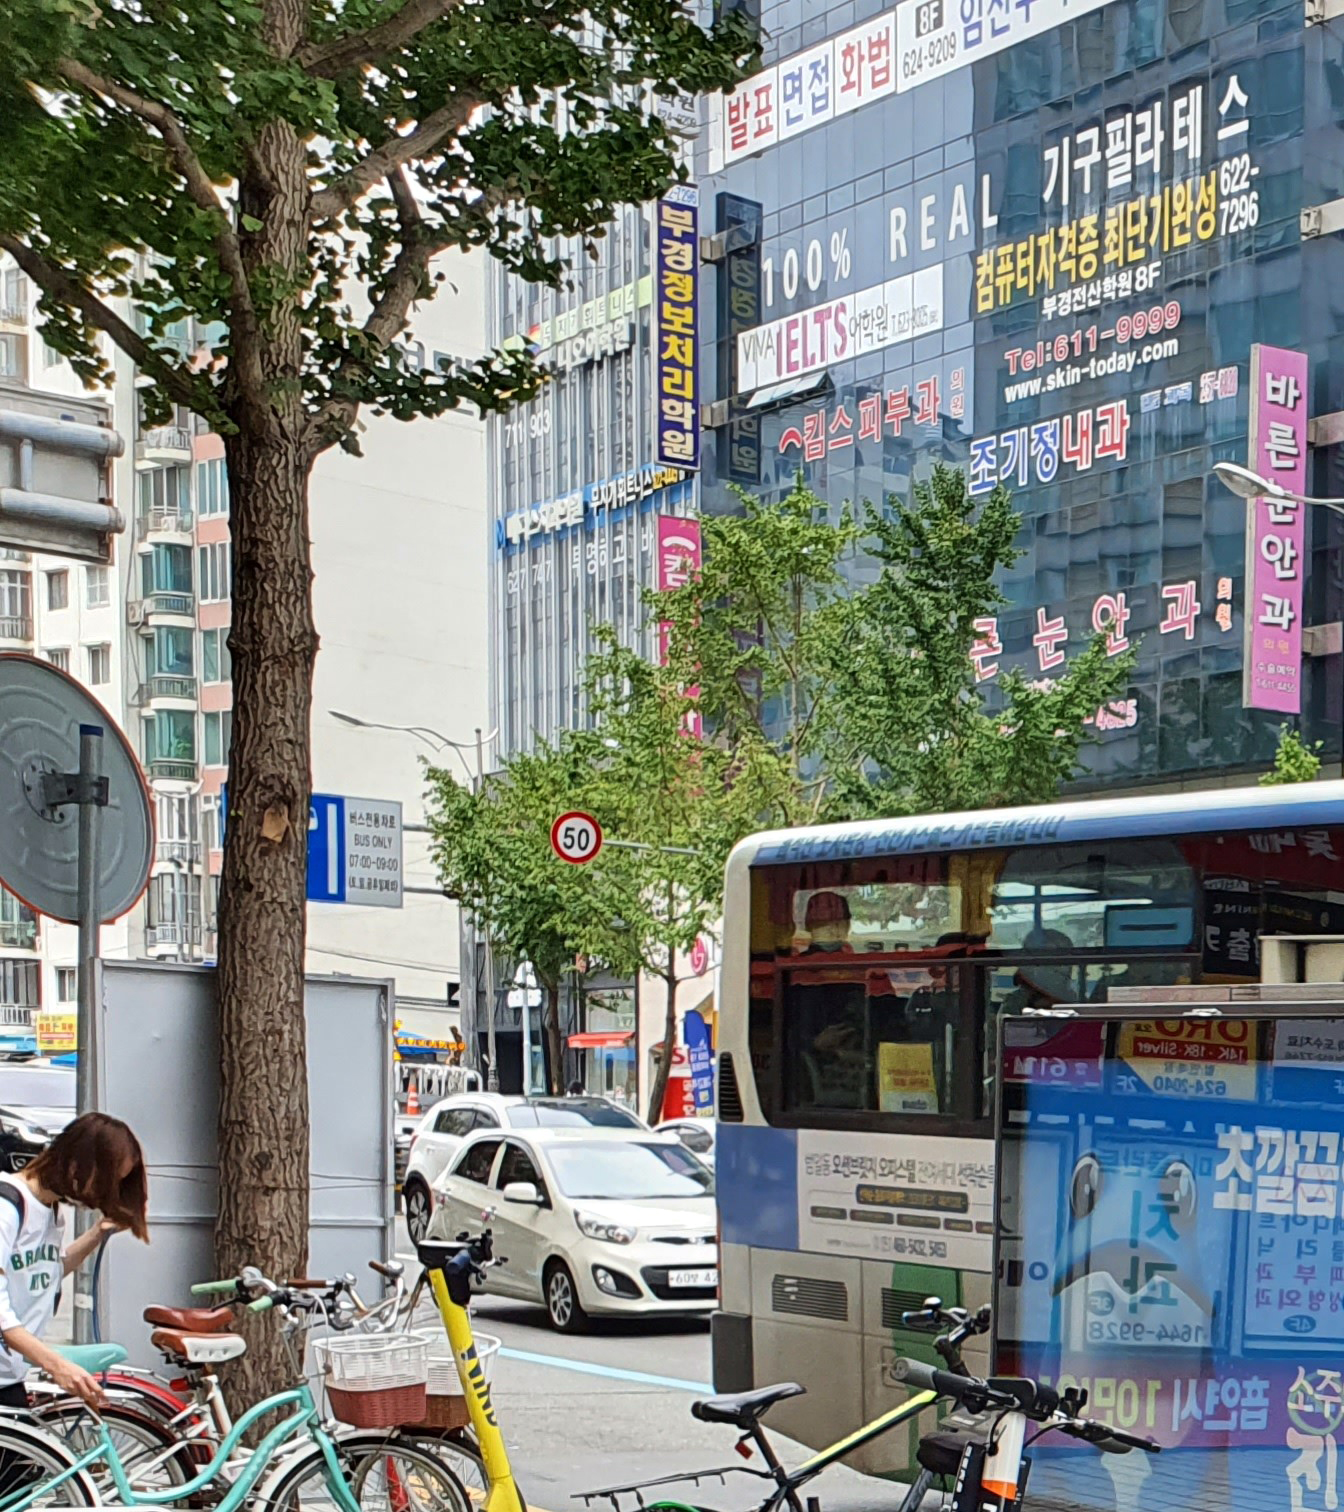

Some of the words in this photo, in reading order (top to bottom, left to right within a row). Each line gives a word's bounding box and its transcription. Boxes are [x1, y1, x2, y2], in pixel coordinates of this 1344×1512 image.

[902, 33, 957, 80] 624-9209
[917, 5, 943, 36] 8F
[728, 83, 774, 151] 발표
[782, 54, 829, 127] 면접
[840, 27, 891, 97] 화법
[1042, 75, 1250, 206] 기구필라테스
[763, 228, 851, 307] 100%
[890, 174, 998, 262] REAL
[976, 213, 1101, 314] 컴퓨터자격증
[1102, 170, 1217, 268] 최단기완성
[1219, 191, 1259, 236] 7296
[1042, 273, 1133, 320] 부경전산학원
[1135, 261, 1163, 292] 8F
[661, 204, 695, 462] 부경정보처리학원
[742, 326, 776, 364] VIVA
[775, 299, 848, 378] IELTS
[849, 303, 889, 348] 어학원
[1005, 301, 1182, 376] Tel:611-9999
[1005, 339, 1180, 404] www.skin-today.com
[800, 376, 940, 463] 킴스피부과
[968, 399, 1130, 497] 조기정내과
[969, 580, 1200, 682] 큰눈안과
[349, 812, 397, 829] 버스전용차로
[354, 834, 371, 848] BUS
[372, 834, 393, 850] ONLY
[562, 826, 590, 852] 50
